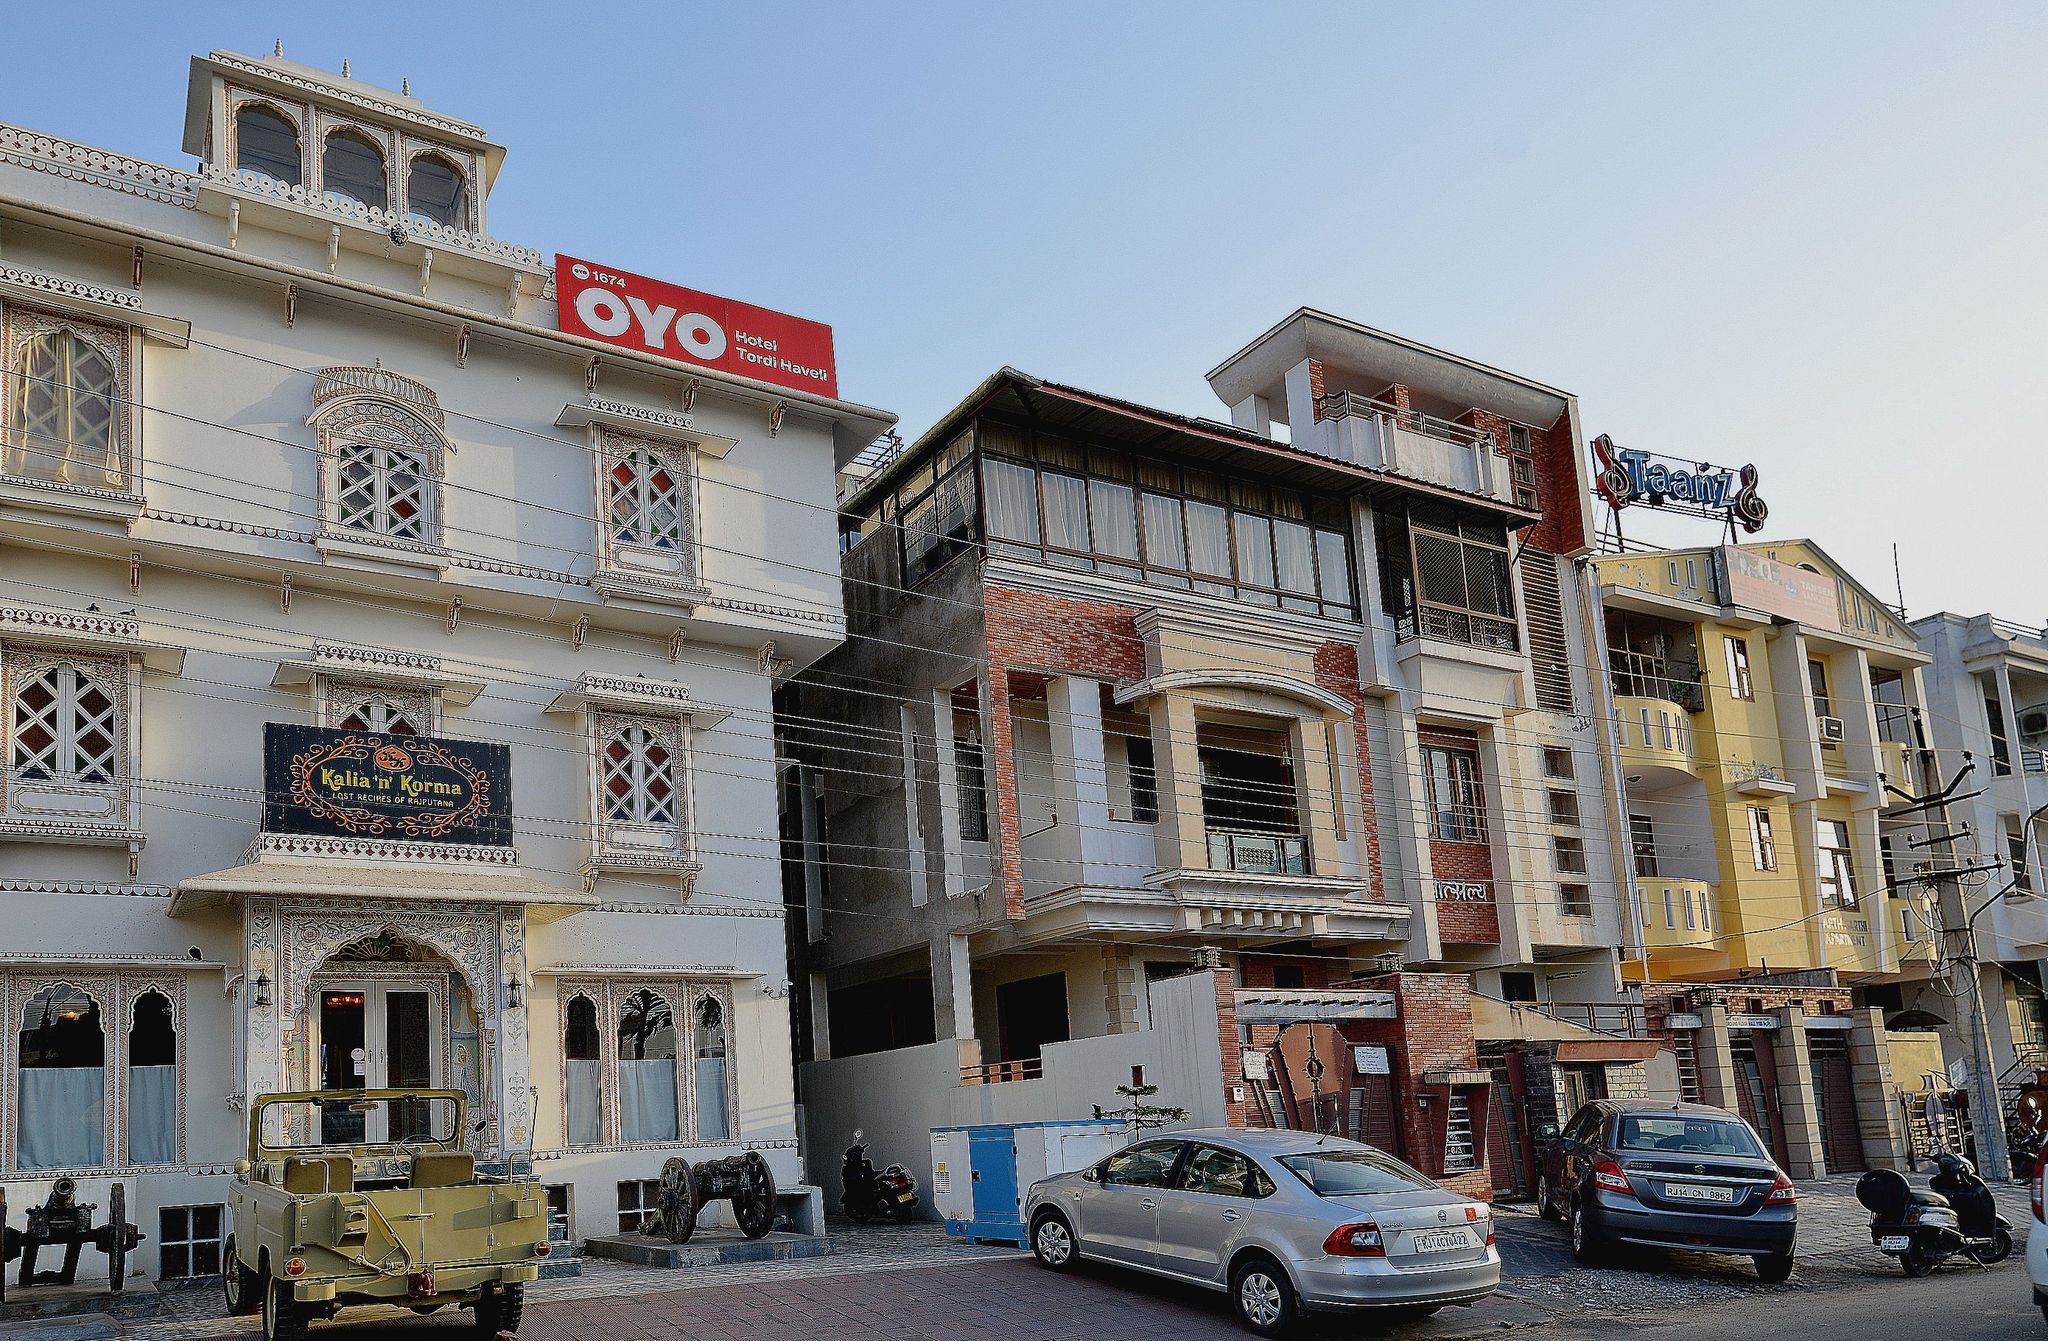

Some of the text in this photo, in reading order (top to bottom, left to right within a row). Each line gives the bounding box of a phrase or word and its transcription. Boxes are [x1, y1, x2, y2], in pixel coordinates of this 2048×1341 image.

[592, 270, 627, 288] 1674
[575, 287, 727, 360] OYO
[735, 330, 777, 352] Hotel
[735, 346, 828, 381] Tordi Haveli
[321, 767, 462, 797] Kalia 'n' Korma
[332, 792, 454, 808] LOST RECIPES OF RAJPUTANA
[1667, 1187, 1732, 1200] RJ14 CN 9862
